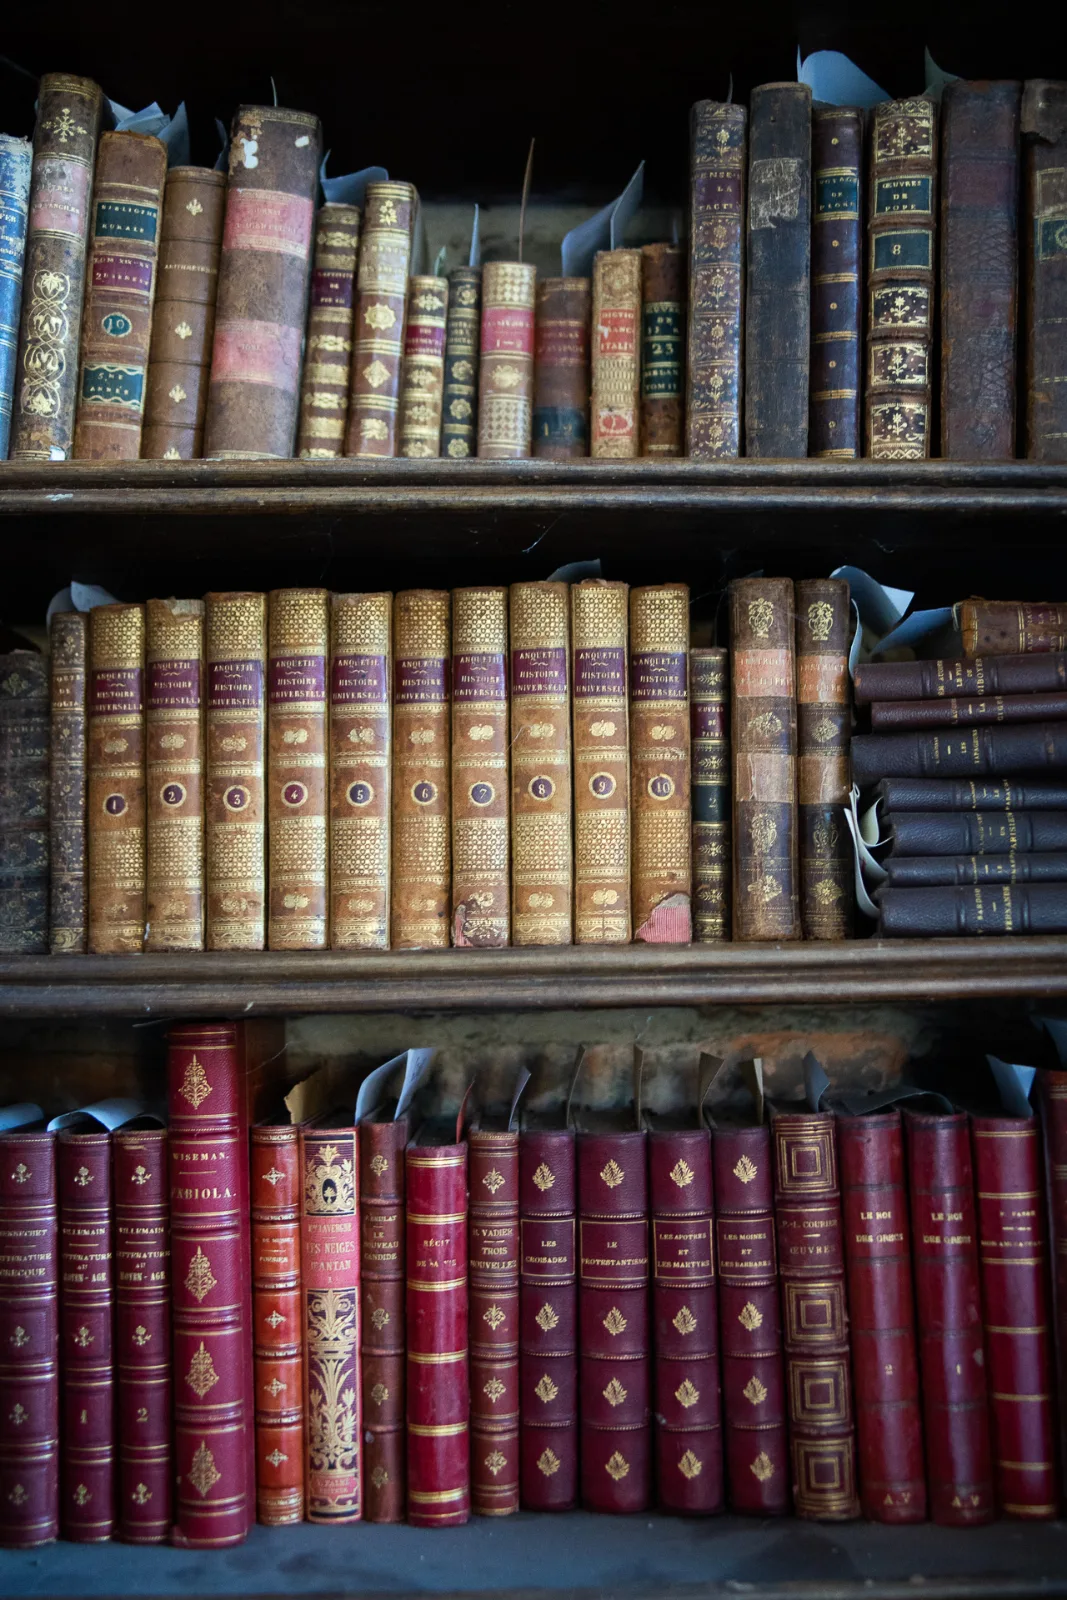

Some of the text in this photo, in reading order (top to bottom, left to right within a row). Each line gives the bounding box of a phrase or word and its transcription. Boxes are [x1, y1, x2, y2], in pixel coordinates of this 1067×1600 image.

[885, 204, 917, 212] POPE
[892, 244, 901, 255] 8
[520, 651, 560, 660] ANQUETIL
[276, 660, 317, 669] ANQUETIL
[338, 659, 379, 668] ANQUETIL
[402, 660, 442, 669] ANQUETIL
[460, 656, 500, 665] ANQUETIL
[214, 664, 255, 673] ANQUETIL
[520, 670, 559, 678] HISTOIRE
[582, 671, 620, 679] HISTOIRE
[975, 658, 984, 695] GIBOYER
[278, 678, 317, 686] HISTOIRE
[339, 678, 378, 687] HISTOIRE
[402, 679, 441, 687] HISTOIRE
[461, 675, 500, 683] HISTOIRE
[640, 675, 680, 683] HISTOIRE
[154, 681, 192, 689] HISTOIRE
[215, 683, 253, 692] HISTOIRE
[97, 691, 134, 699] HISTOIRE
[149, 696, 201, 705] NIVERSELLE
[94, 703, 143, 712] NIVERSELLE
[979, 703, 986, 713] LA
[538, 783, 545, 795] 8
[599, 781, 606, 793] 9
[656, 781, 669, 793] 10
[168, 791, 176, 802] 2
[291, 789, 298, 799] 4
[357, 789, 364, 800] 5
[422, 787, 428, 798] 6
[479, 788, 487, 800] 7
[233, 794, 241, 805] 3
[708, 797, 717, 808] 2
[112, 800, 116, 810] 1
[173, 1152, 229, 1160] WISEMAN.
[861, 1211, 892, 1220] LE ROI
[931, 1213, 944, 1221] LE
[803, 1219, 837, 1228] COURIER
[481, 1228, 513, 1237] VADIER
[325, 1240, 355, 1254] NEIGES
[482, 1247, 508, 1255] TROIS
[790, 1245, 836, 1254] ŒUVRES
[673, 1260, 710, 1268] MARTYRS
[136, 1407, 148, 1422] 2
